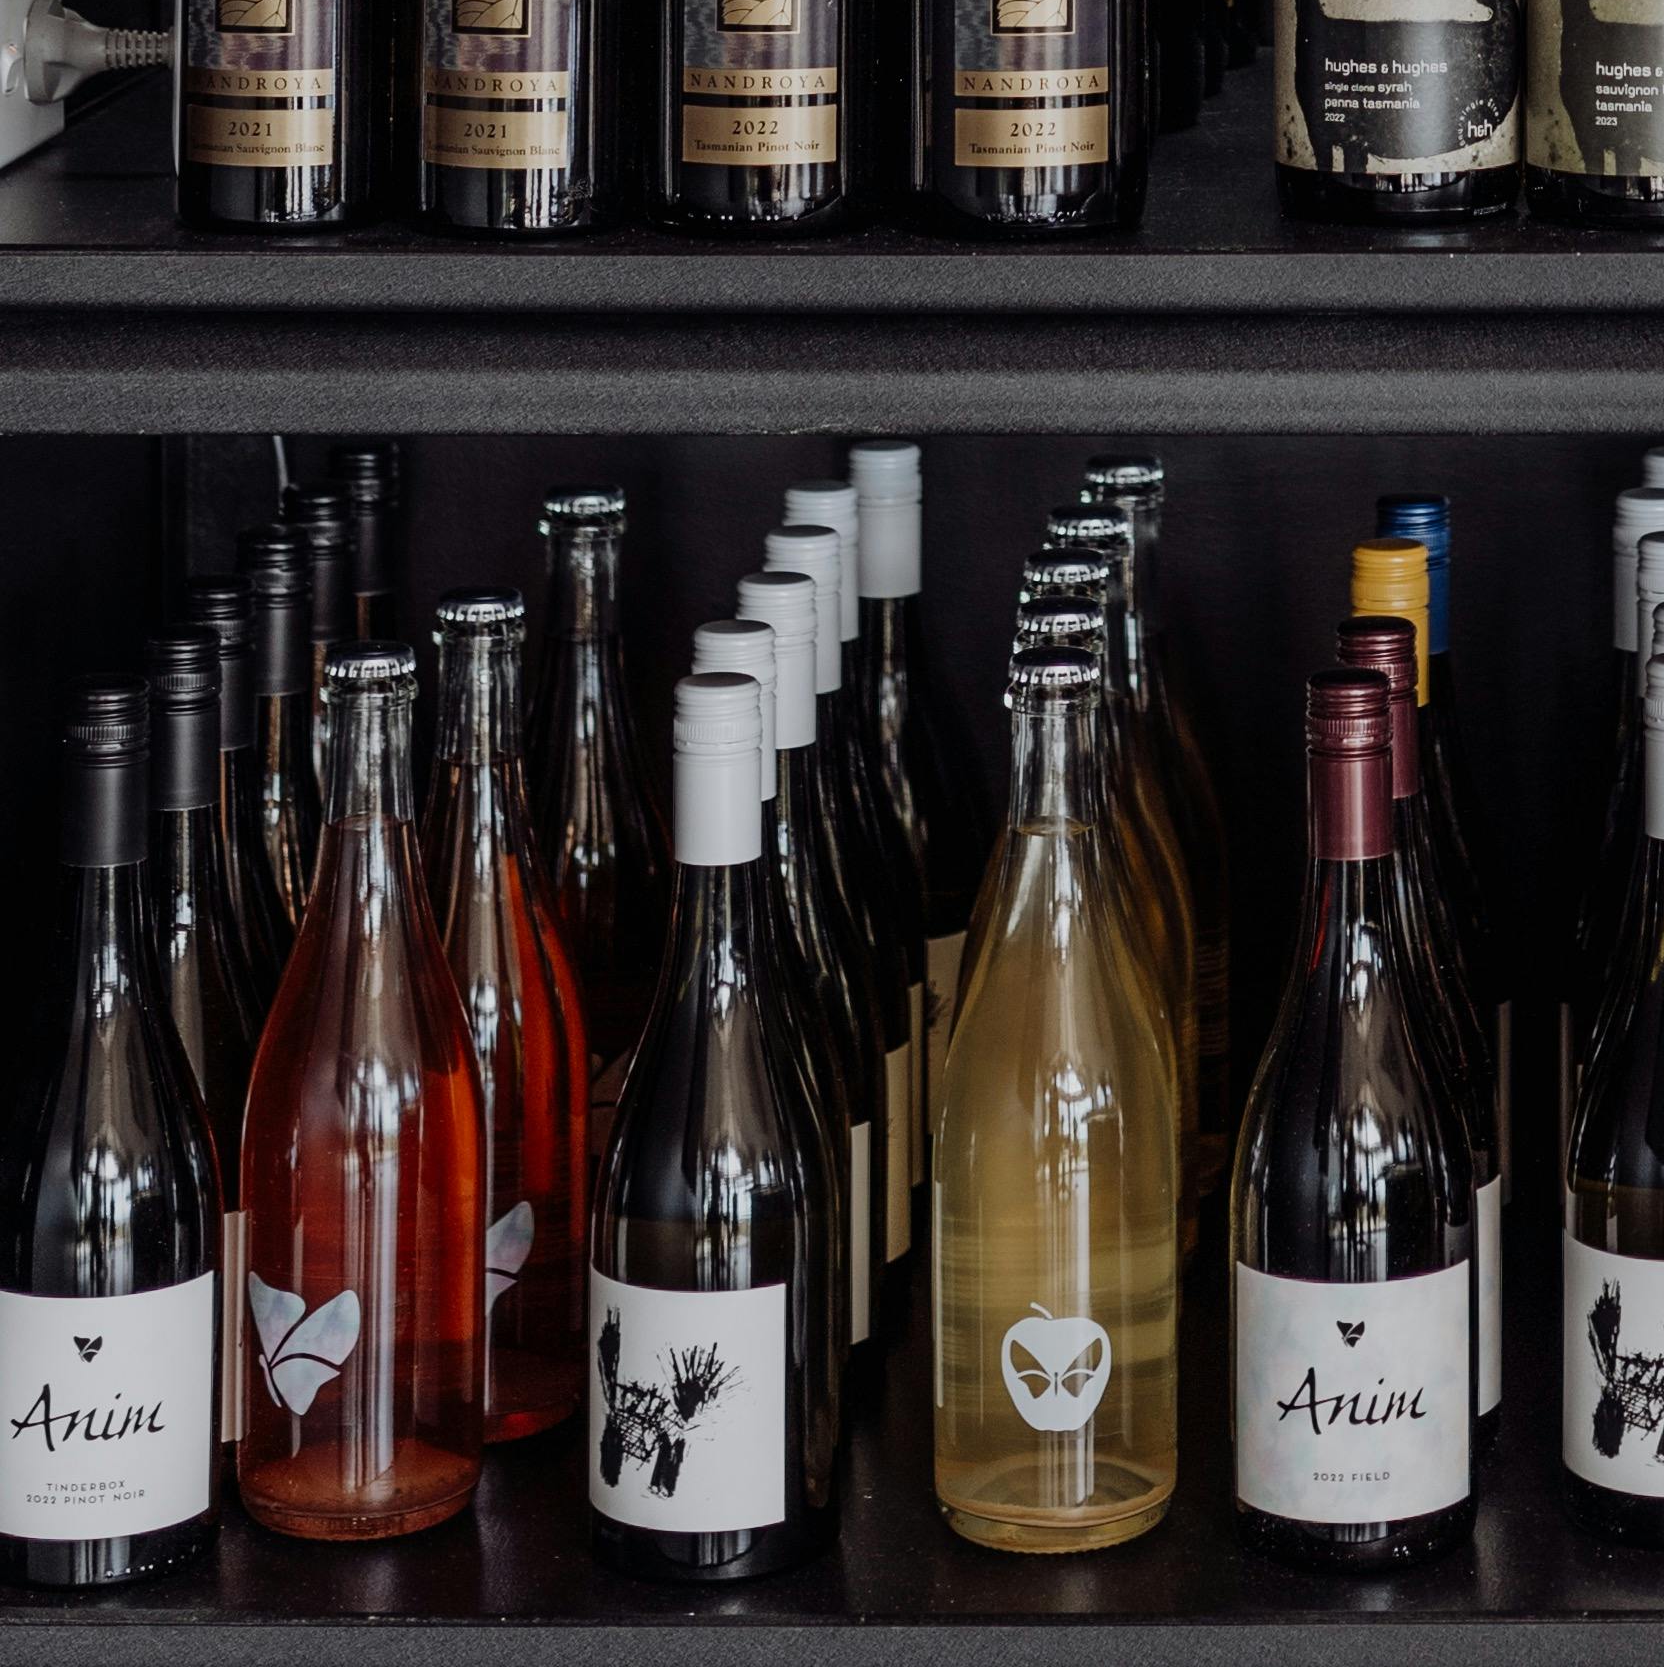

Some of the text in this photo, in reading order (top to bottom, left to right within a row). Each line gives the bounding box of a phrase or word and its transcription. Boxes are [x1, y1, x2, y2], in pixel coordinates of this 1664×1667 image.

[1325, 58, 1448, 77] hughes & hughes
[1596, 61, 1651, 79] hughes
[1655, 67, 1663, 77] &
[431, 75, 557, 92] NANDROYA
[690, 74, 828, 90] NANDROYA
[963, 74, 1101, 91] NANDROYA
[1324, 81, 1412, 94] single clone syrah
[1596, 83, 1659, 98] sauvignon
[1324, 97, 1420, 109] penna tasmania
[1596, 99, 1652, 112] tasmania
[1324, 113, 1345, 122] 2022
[1595, 116, 1618, 126] 2023
[228, 122, 272, 137] 2021
[463, 123, 507, 138] 2021
[732, 120, 779, 136] 2022
[1010, 121, 1057, 138] 2022
[1468, 119, 1493, 138] h&h
[234, 143, 290, 155] Sauvignon
[295, 143, 325, 153] Blanc
[471, 146, 560, 157] Sauvignon Blanc
[695, 140, 820, 153] Tasmanian Pinot Noir
[969, 140, 1095, 155] Tasmanian Pinot Noir
[1277, 1367, 1427, 1434] Anim
[11, 1383, 165, 1452] Anim
[1313, 1470, 1391, 1482] 2022 FIELD
[46, 1480, 126, 1492] TINDERBOX
[26, 1489, 145, 1505] 2022 PINOT NOIR
